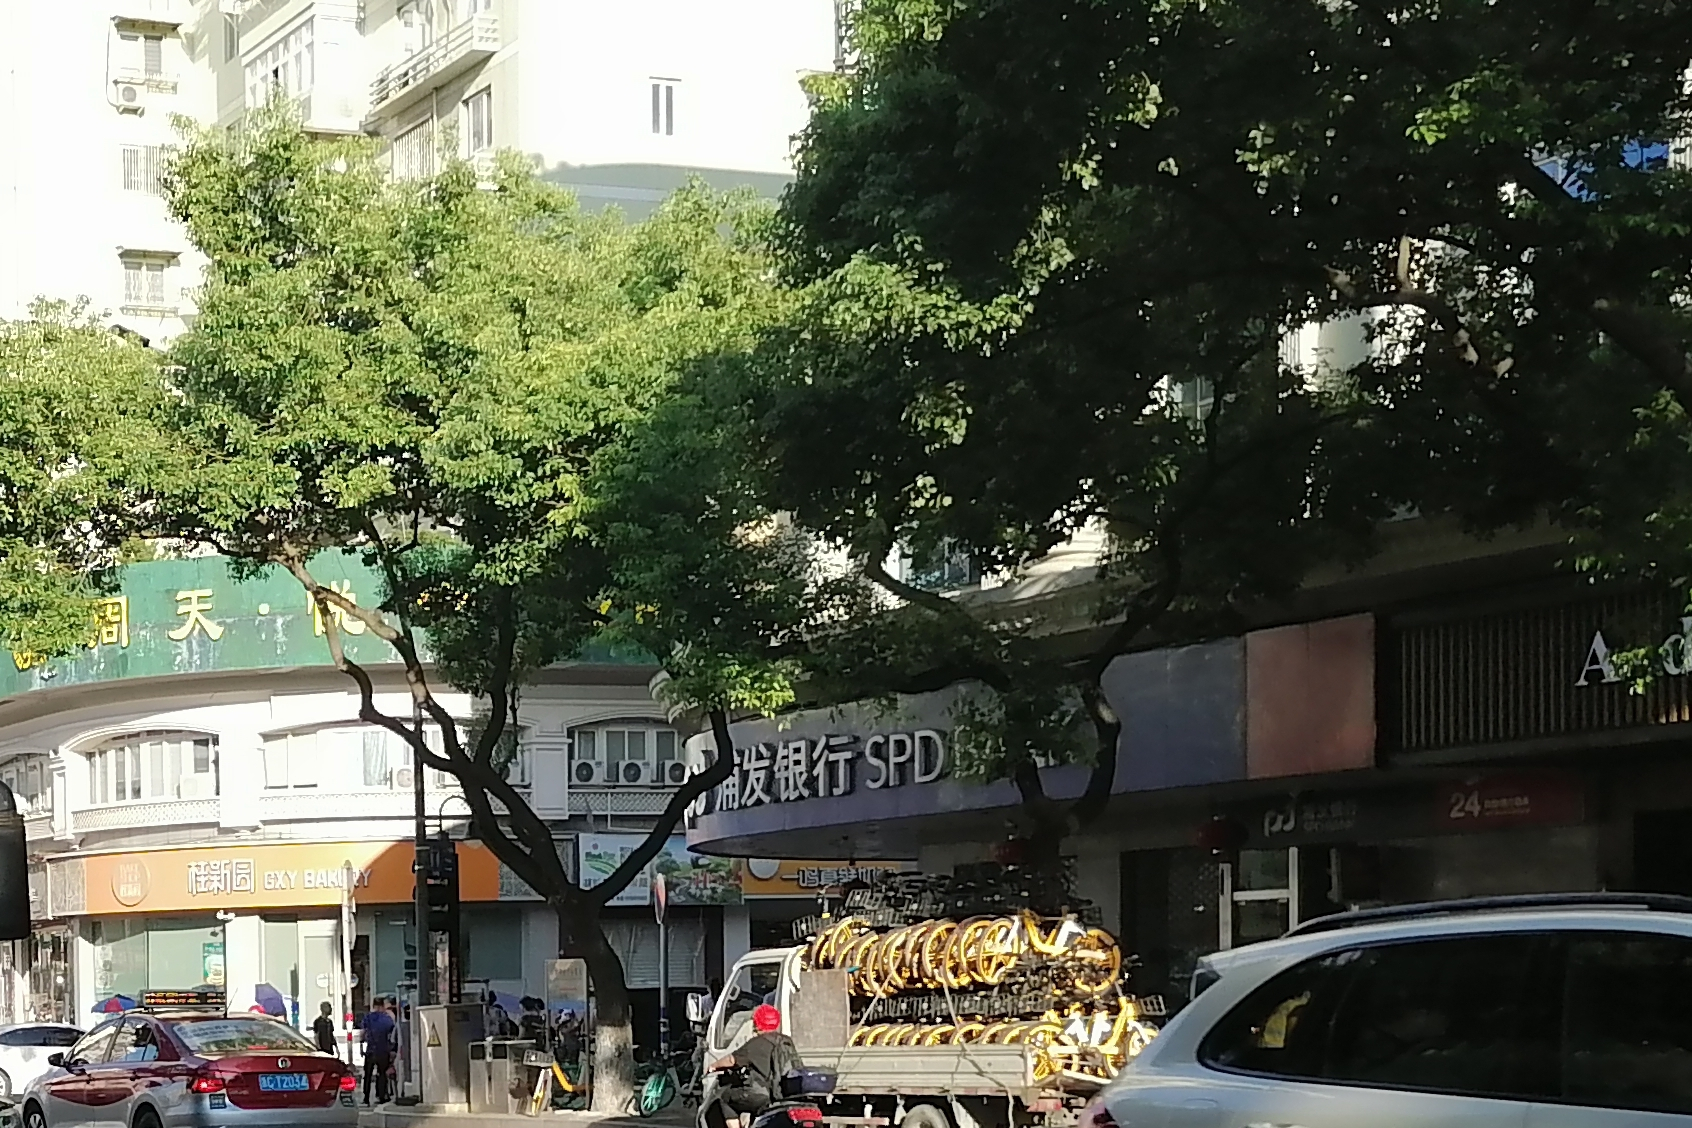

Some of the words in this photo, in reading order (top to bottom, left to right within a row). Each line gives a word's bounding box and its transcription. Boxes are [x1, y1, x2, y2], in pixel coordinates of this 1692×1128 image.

[717, 735, 854, 812] 浦发银行
[865, 729, 945, 789] SPD
[1450, 791, 1481, 819] 24
[187, 859, 254, 896] 桂新园
[264, 871, 297, 890] GXY
